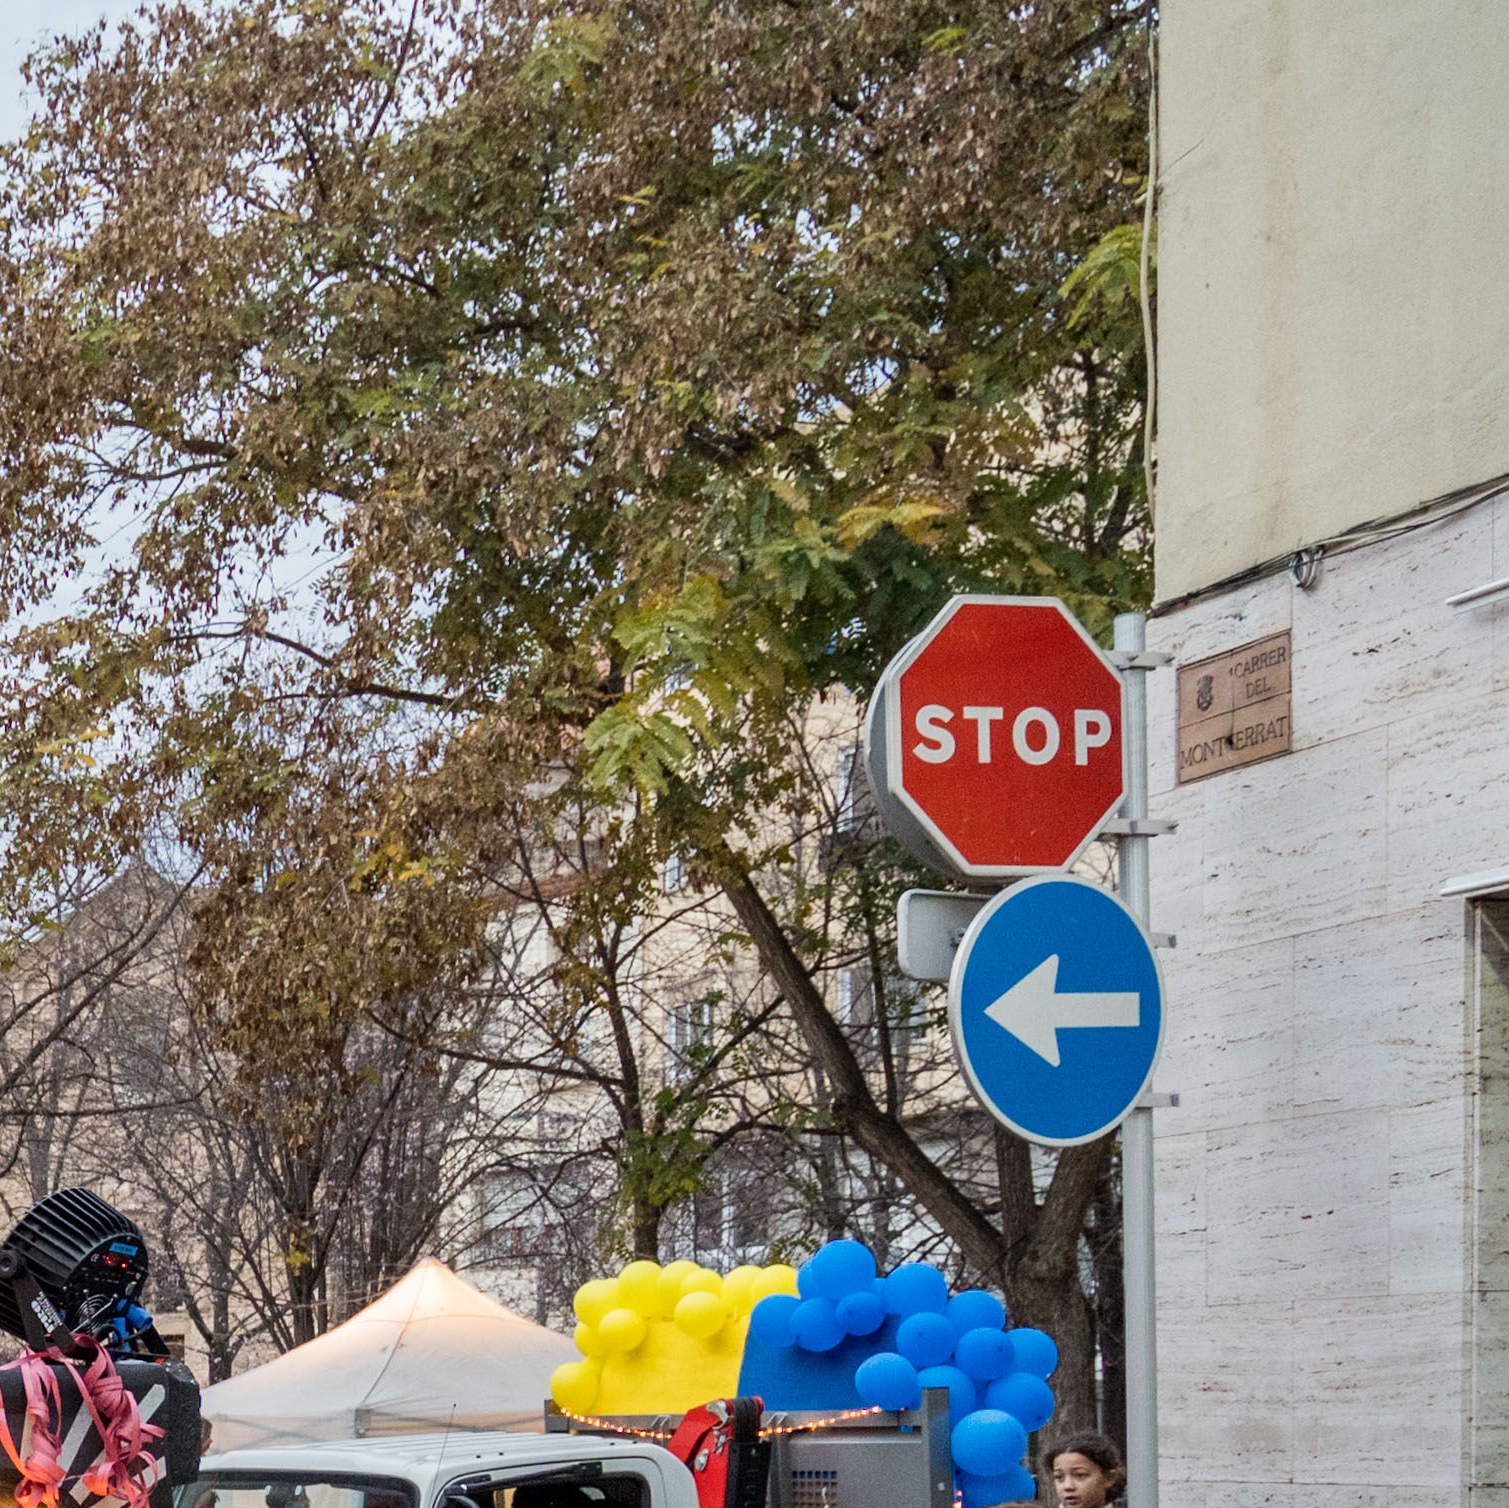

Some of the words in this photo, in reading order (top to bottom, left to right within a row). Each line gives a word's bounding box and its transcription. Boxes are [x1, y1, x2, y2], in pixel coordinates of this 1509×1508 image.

[1234, 646, 1287, 679] CARRER
[1245, 677, 1272, 700] DEL
[912, 703, 1112, 766] STOP
